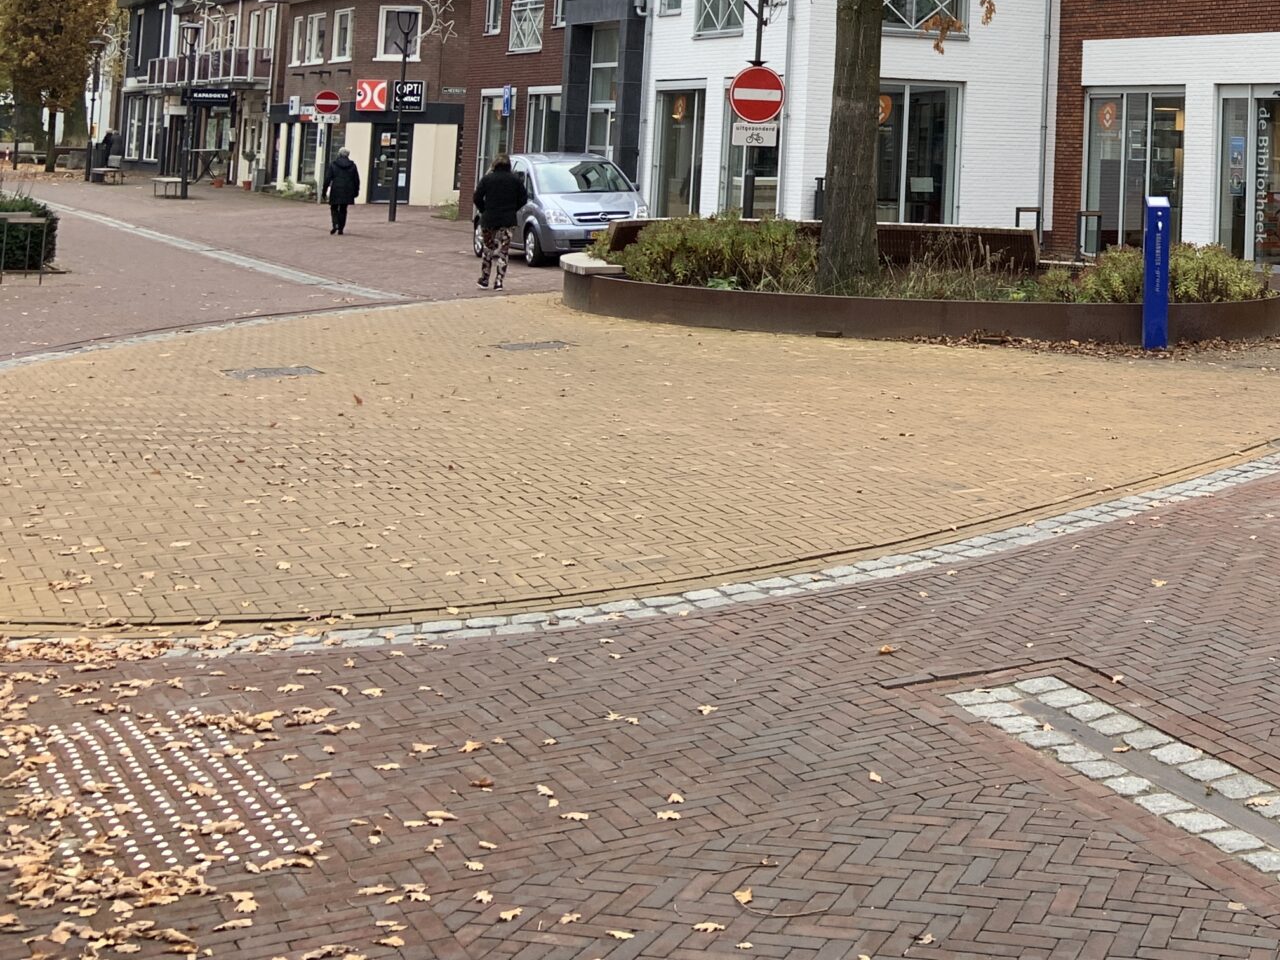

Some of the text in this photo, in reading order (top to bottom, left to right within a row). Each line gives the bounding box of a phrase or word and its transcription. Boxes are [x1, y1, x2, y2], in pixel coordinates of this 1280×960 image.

[396, 83, 422, 94] OPTI
[1255, 107, 1271, 244] de Bibliotheek
